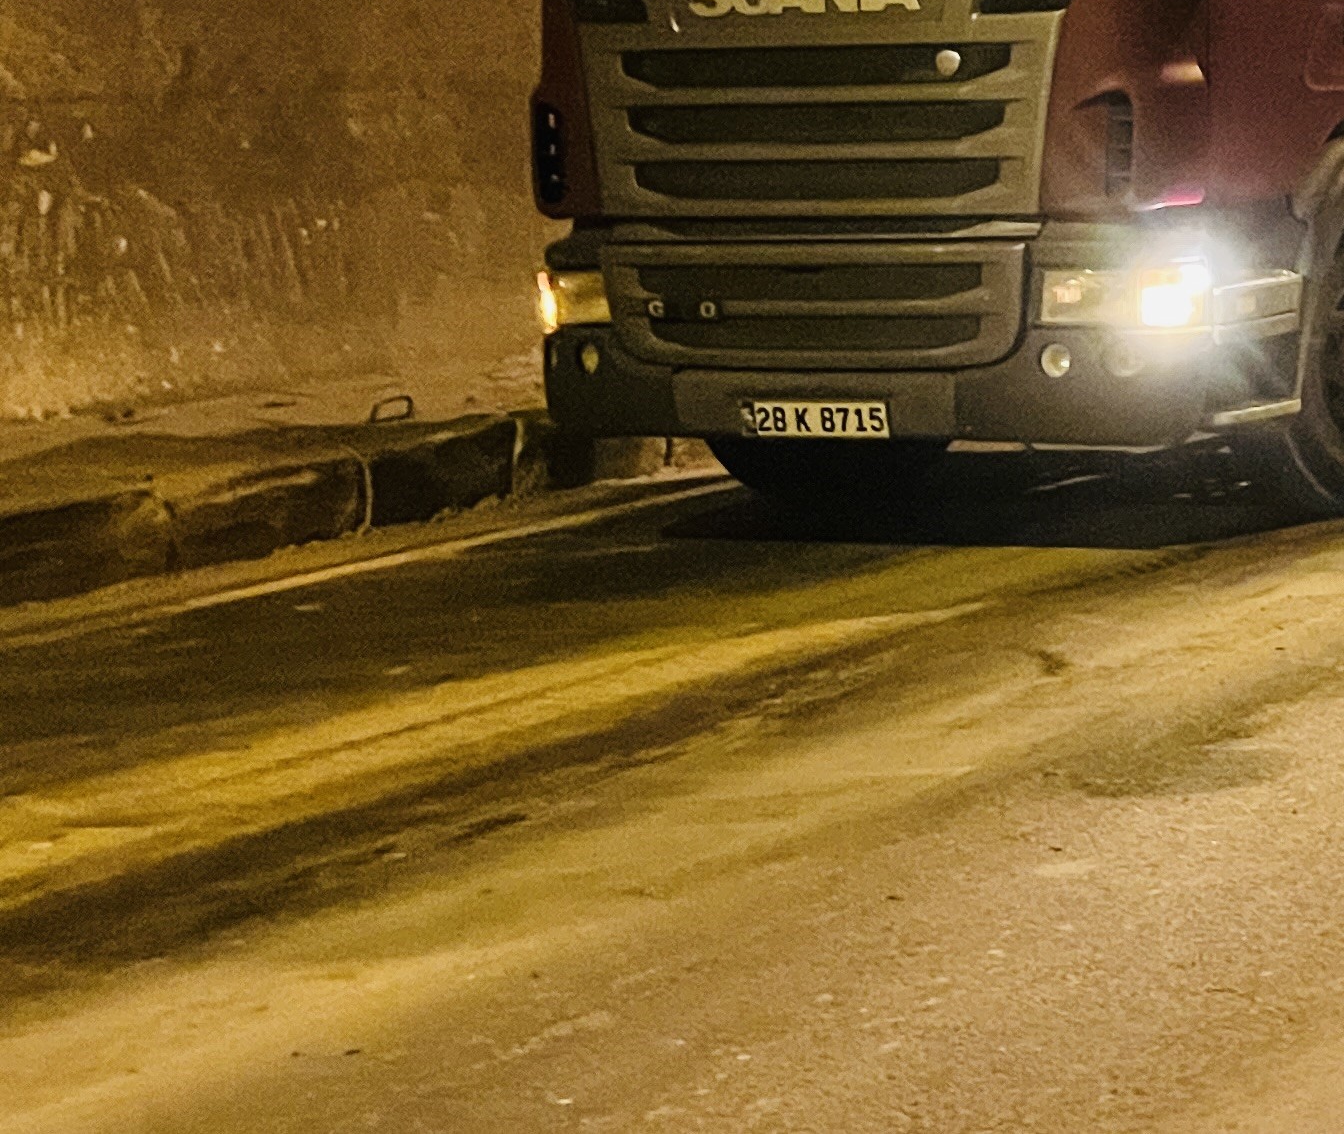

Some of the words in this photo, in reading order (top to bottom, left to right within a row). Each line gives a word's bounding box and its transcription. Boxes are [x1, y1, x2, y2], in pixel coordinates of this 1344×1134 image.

[756, 406, 787, 432] 28
[794, 407, 811, 432] K
[820, 406, 885, 433] 8715
